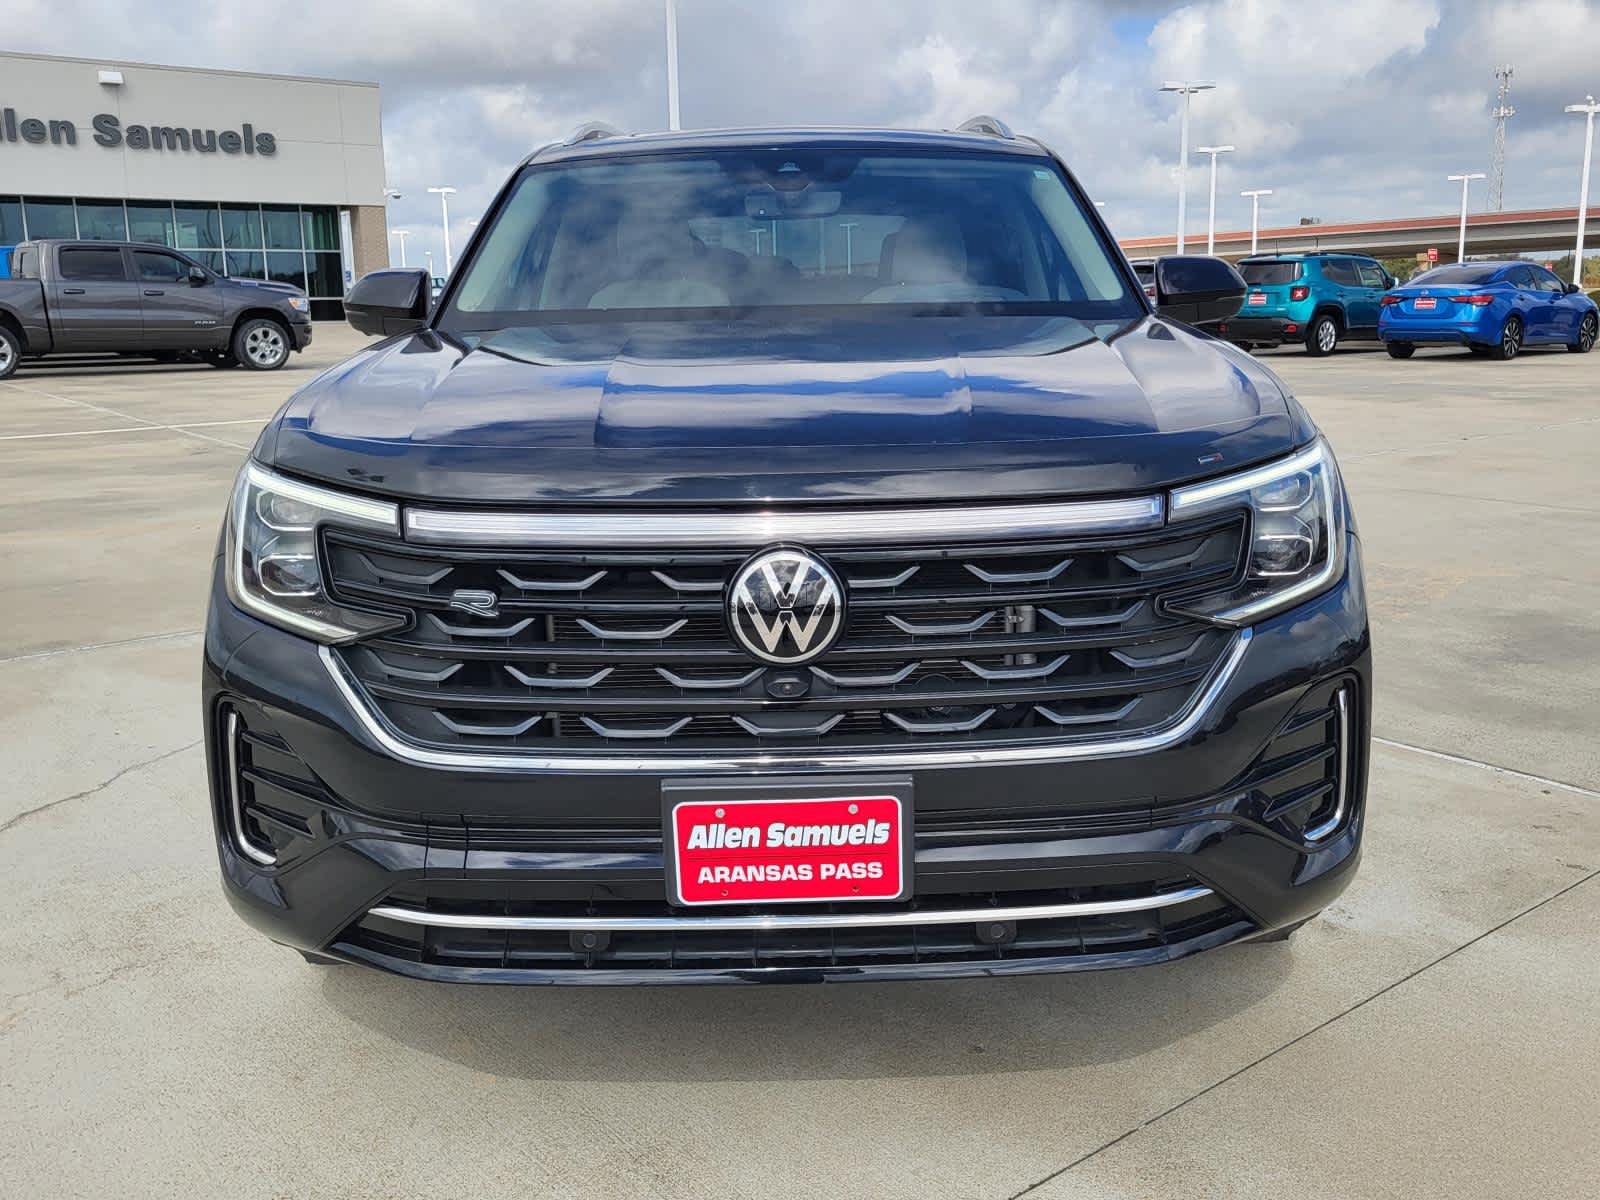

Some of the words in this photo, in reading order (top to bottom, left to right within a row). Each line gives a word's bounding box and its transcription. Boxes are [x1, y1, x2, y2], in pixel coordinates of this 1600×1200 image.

[0, 108, 76, 145] len
[92, 114, 276, 155] Samuels
[687, 824, 760, 849] Allen
[766, 819, 890, 848] Samuels
[698, 864, 813, 884] ARANSAS
[820, 862, 883, 880] PASS
